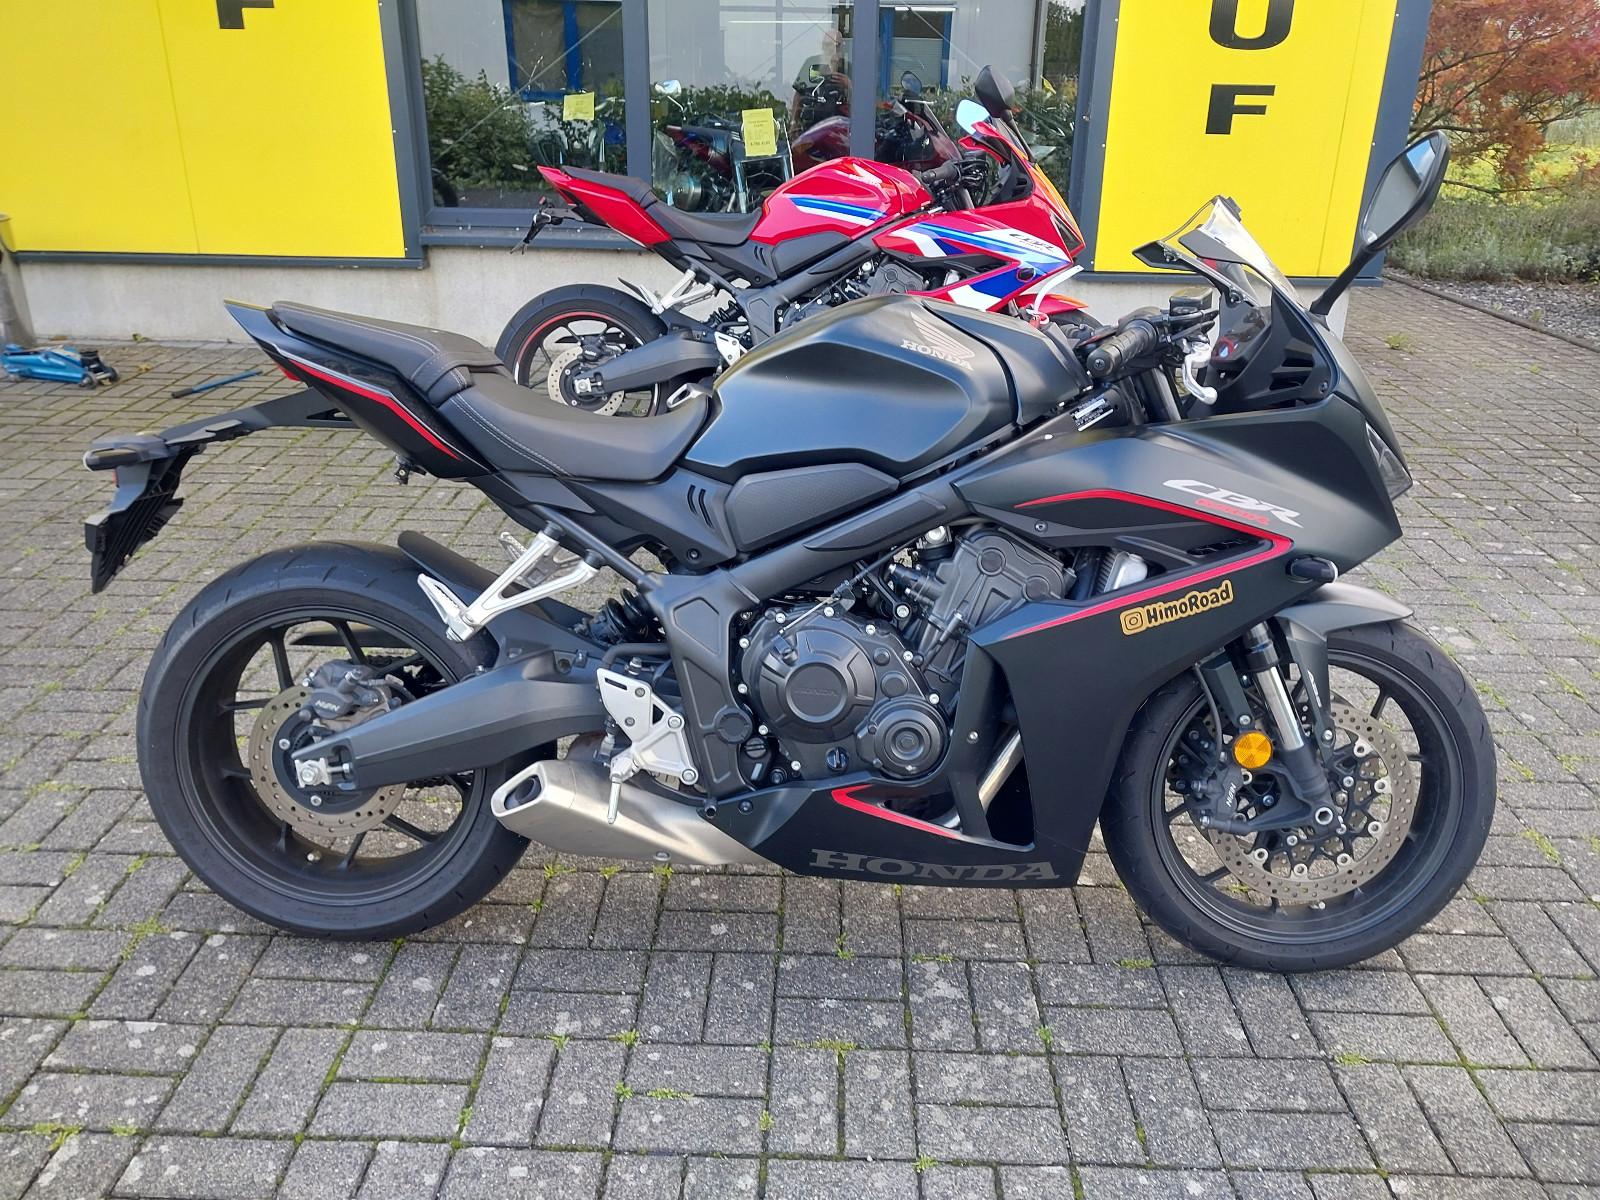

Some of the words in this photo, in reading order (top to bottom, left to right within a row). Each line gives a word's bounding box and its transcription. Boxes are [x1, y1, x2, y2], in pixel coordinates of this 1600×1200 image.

[900, 339, 974, 371] HONDA
[1162, 479, 1304, 528] CBR
[1145, 583, 1232, 624] HimoRoad
[809, 849, 1060, 880] HONDA
